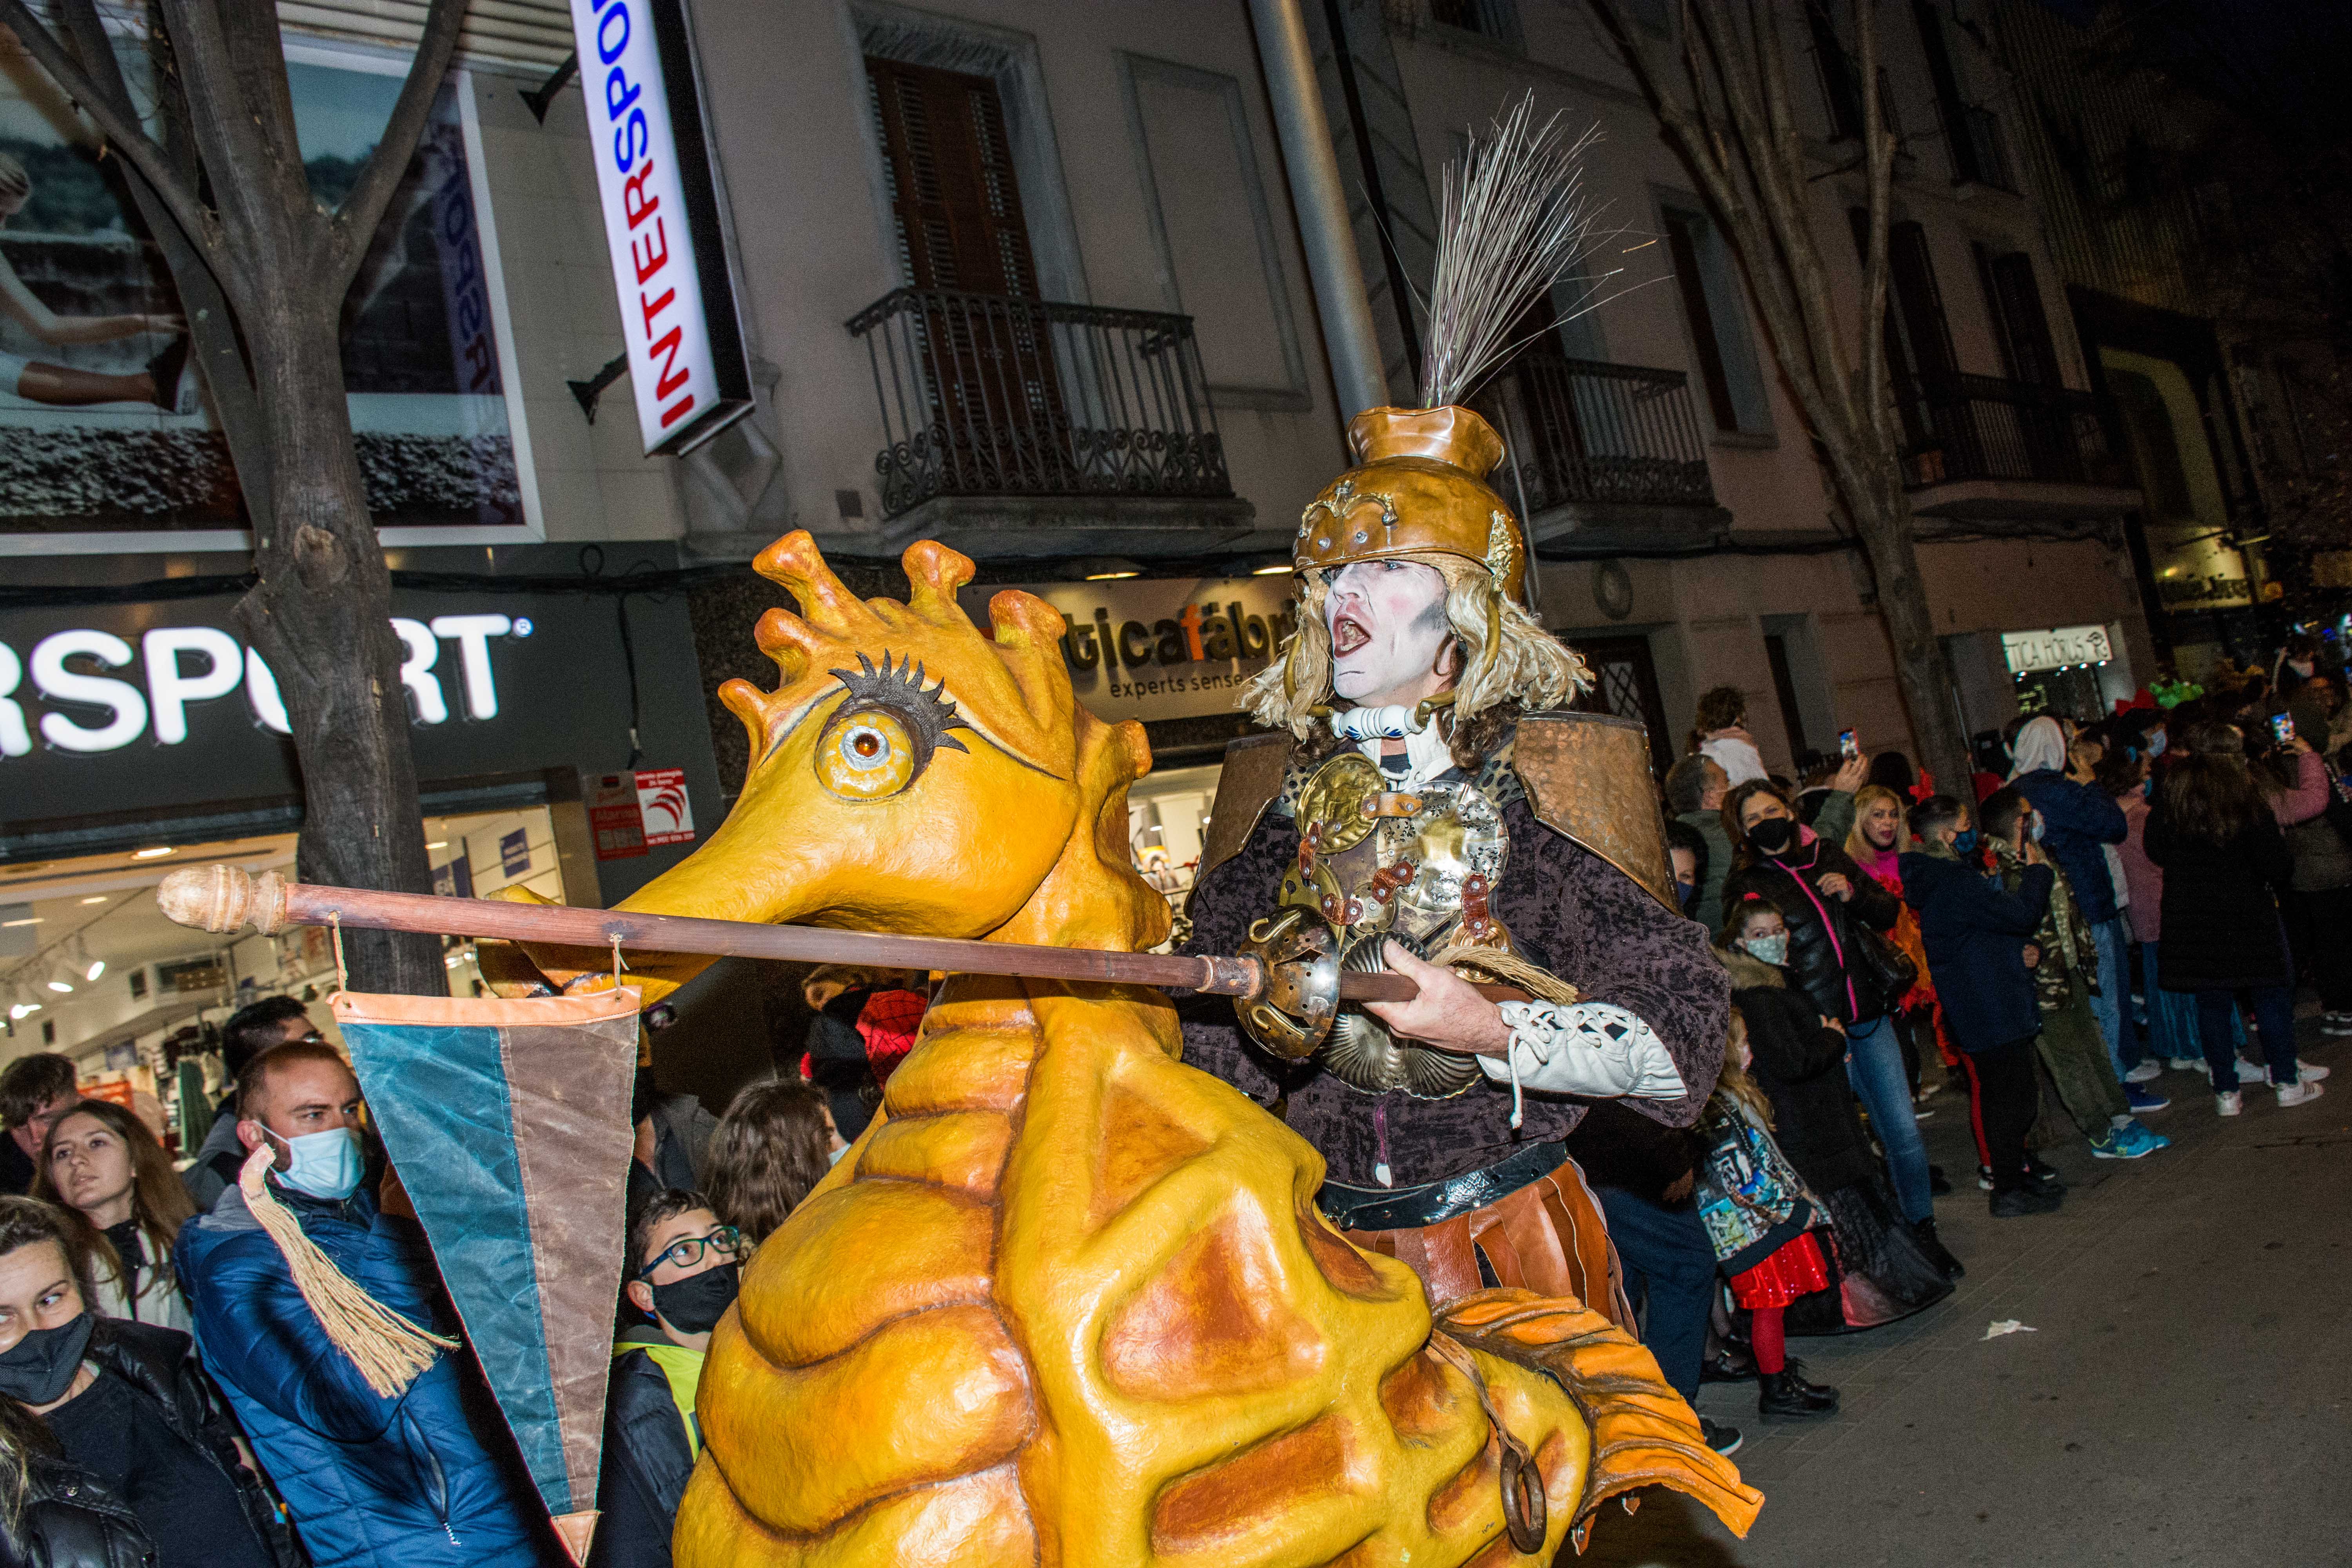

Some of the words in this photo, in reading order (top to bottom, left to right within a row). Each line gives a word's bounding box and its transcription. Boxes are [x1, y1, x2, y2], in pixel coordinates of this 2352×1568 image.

[591, 0, 695, 429] INTERSPO
[1110, 673, 1186, 701] experts
[1191, 673, 1243, 691] sense
